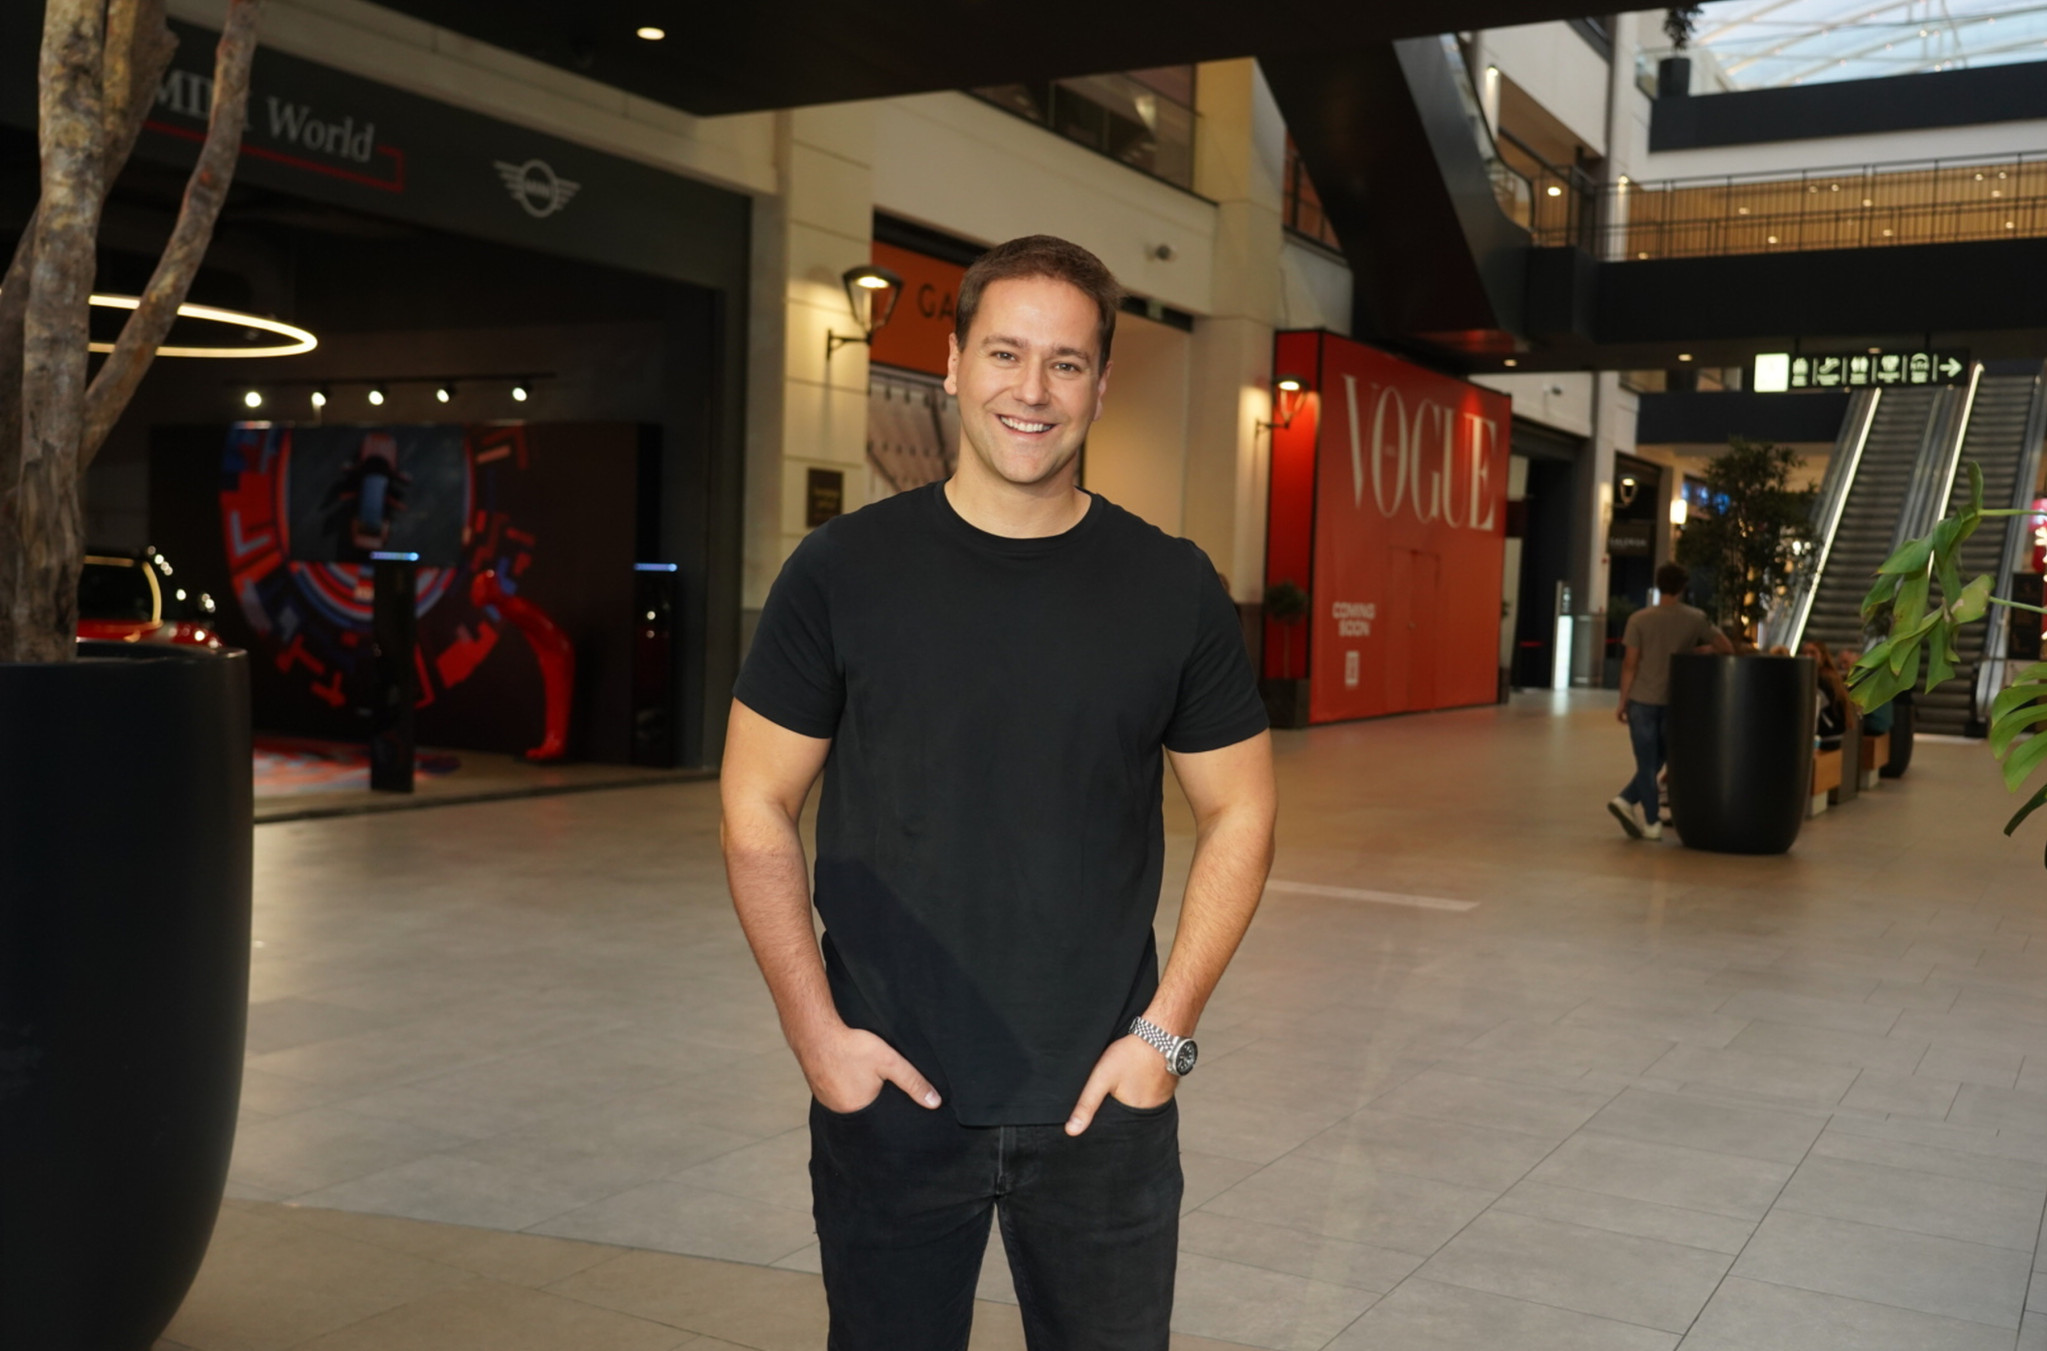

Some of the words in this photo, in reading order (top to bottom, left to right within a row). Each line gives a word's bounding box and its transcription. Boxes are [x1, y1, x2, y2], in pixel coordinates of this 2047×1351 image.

[156, 69, 253, 131] MI
[266, 96, 375, 163] World
[1342, 374, 1497, 531] VOGUE
[1332, 601, 1376, 620] COMING
[1338, 619, 1371, 637] SOON
